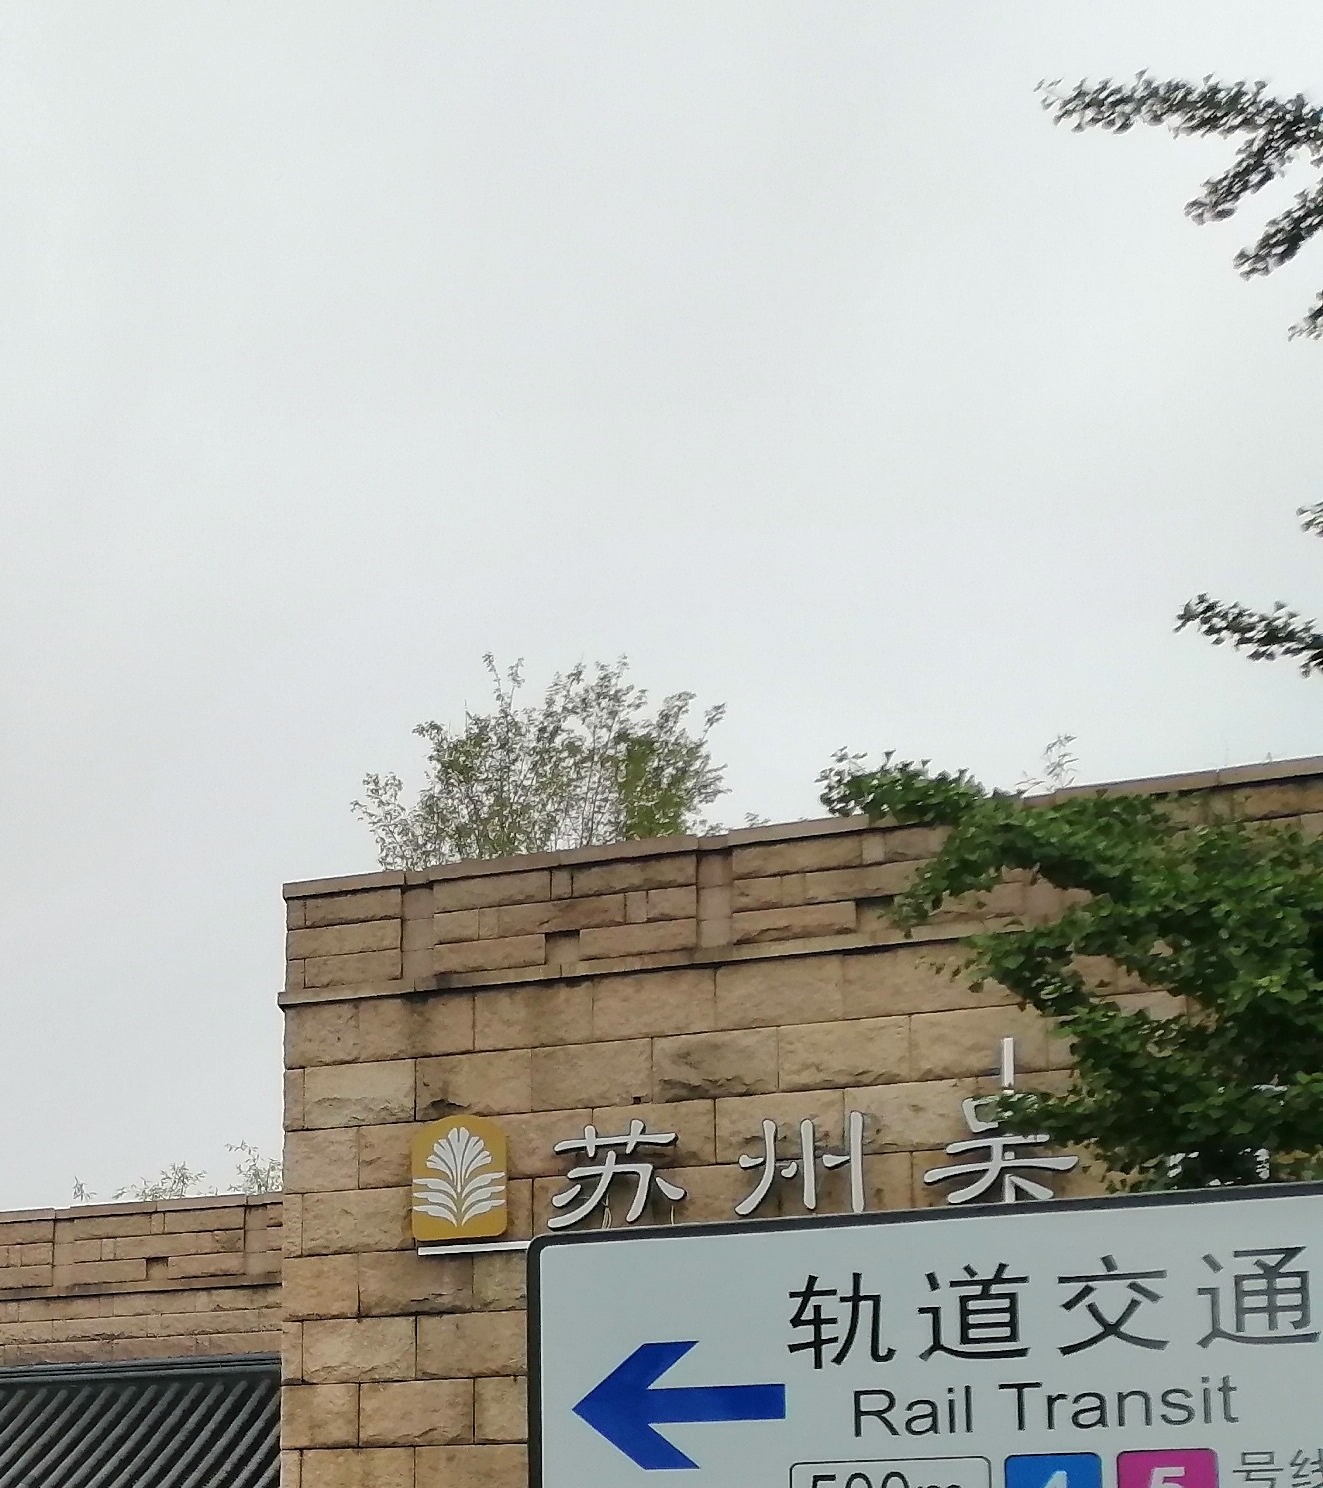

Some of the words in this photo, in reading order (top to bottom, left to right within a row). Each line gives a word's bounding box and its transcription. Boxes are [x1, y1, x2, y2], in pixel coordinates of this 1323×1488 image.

[788, 1246, 1322, 1369] 轨道交通
[853, 1385, 973, 1437] Rail
[998, 1376, 1240, 1431] Transit
